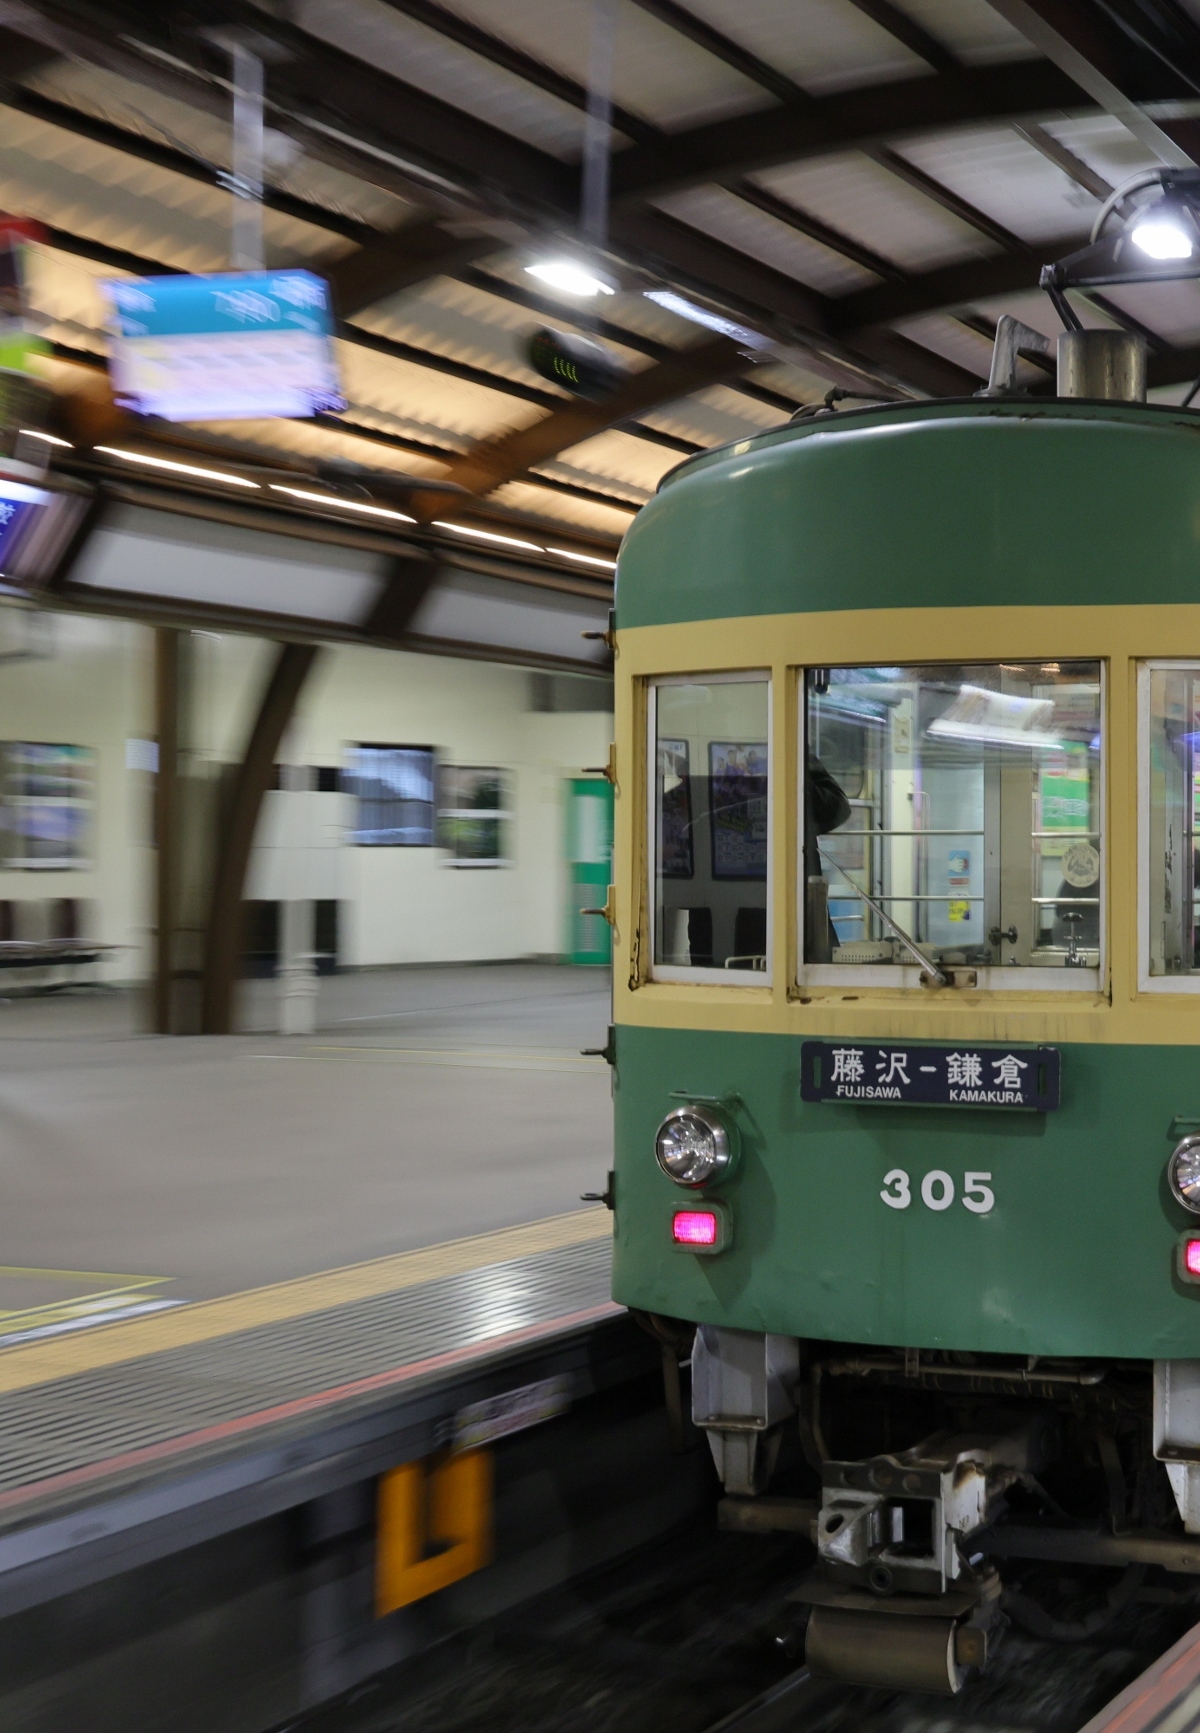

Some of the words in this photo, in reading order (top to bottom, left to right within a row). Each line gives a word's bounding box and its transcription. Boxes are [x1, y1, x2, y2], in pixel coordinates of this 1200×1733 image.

[835, 1084, 902, 1099] FUJISAWA
[949, 1089, 1024, 1104] KAMAKURA
[879, 1168, 995, 1214] 305
